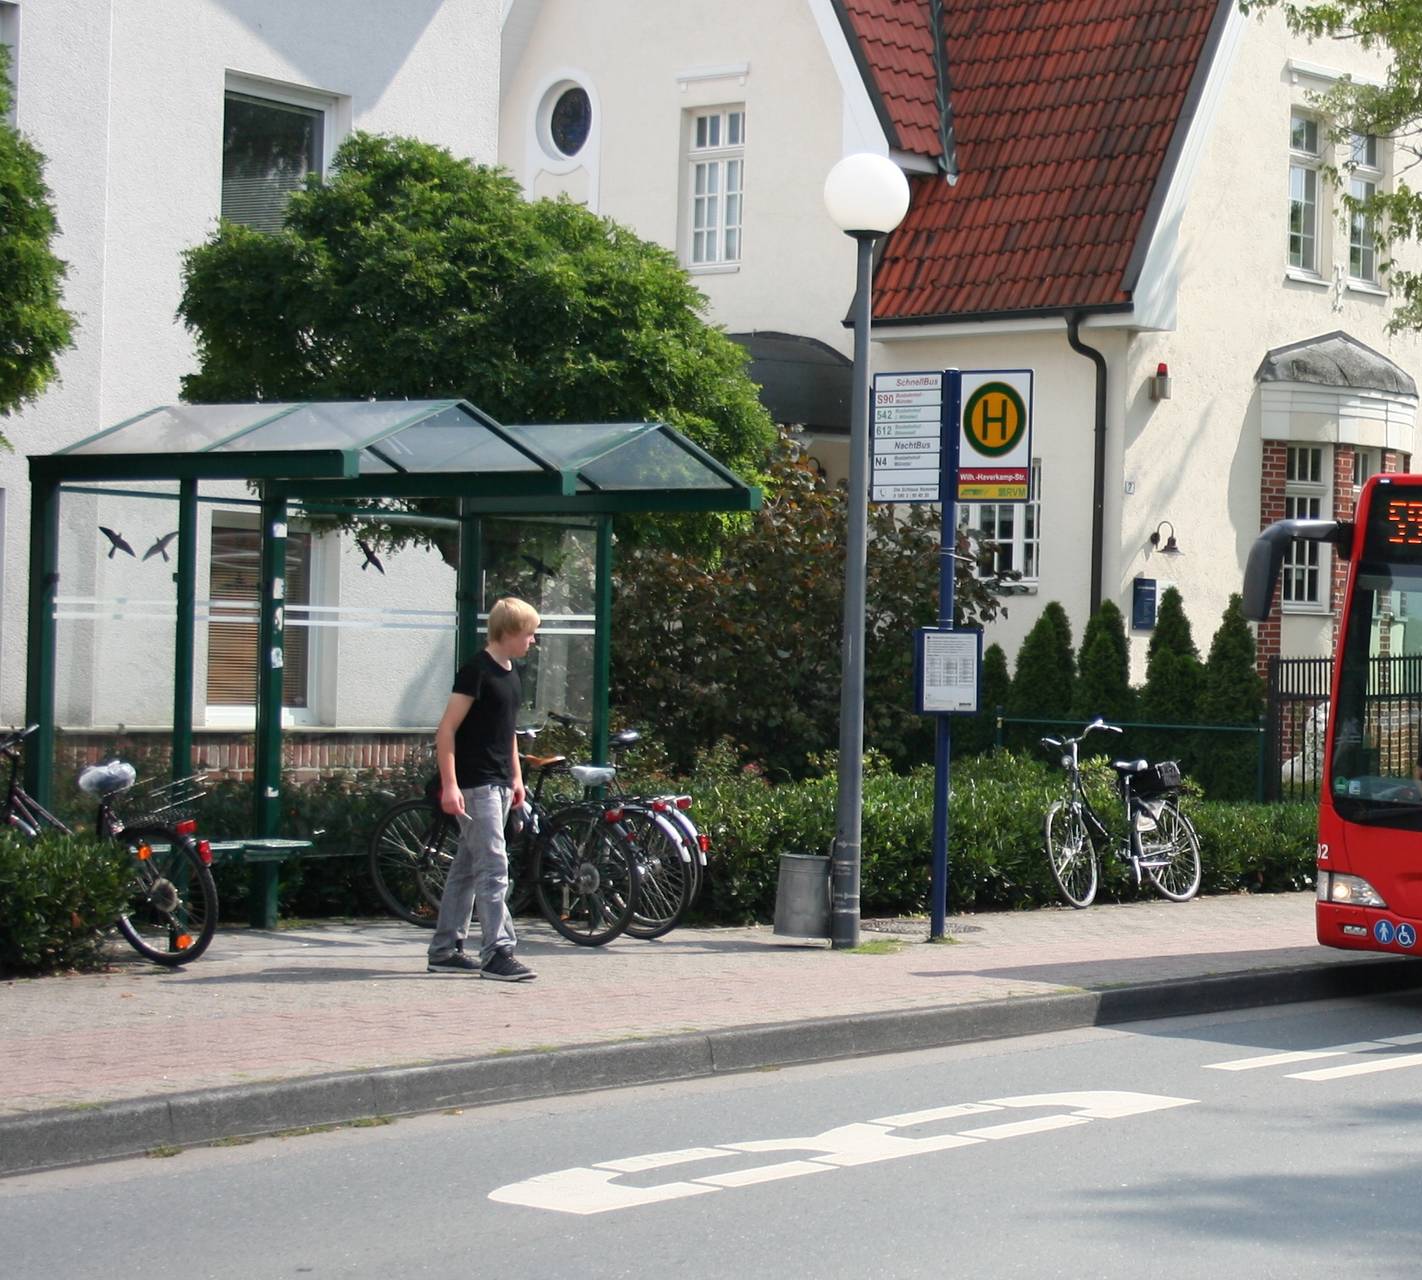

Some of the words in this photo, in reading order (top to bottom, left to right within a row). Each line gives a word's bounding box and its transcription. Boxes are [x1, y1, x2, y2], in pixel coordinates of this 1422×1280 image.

[896, 378, 939, 387] SchnellBus
[877, 394, 895, 405] S90
[876, 410, 893, 420] 542
[982, 399, 1007, 441] H
[876, 426, 893, 436] 612
[894, 441, 931, 450] NachtBus
[875, 457, 888, 467] N4
